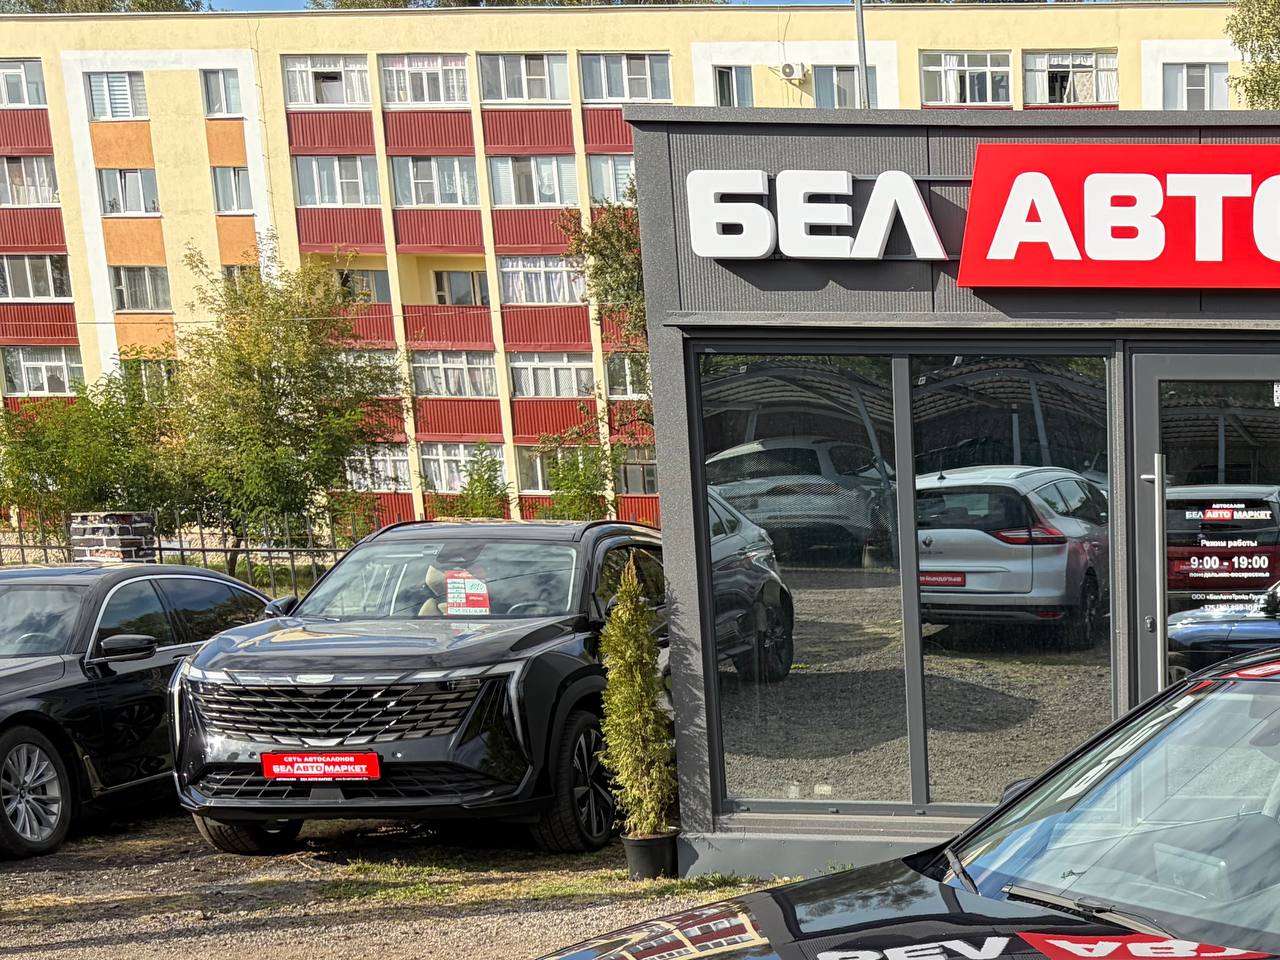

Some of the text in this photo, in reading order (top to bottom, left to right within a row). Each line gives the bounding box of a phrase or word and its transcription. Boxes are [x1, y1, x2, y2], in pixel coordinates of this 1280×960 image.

[686, 168, 949, 262] БЕЛ
[1185, 510, 1272, 520] БЕЛ АВТО МАРКЕТ
[1227, 539, 1258, 549] работы
[1190, 556, 1219, 569] 9:00
[1231, 555, 1269, 569] 19:00
[272, 764, 368, 773] БЕЛ АВТО МАРКЕТ
